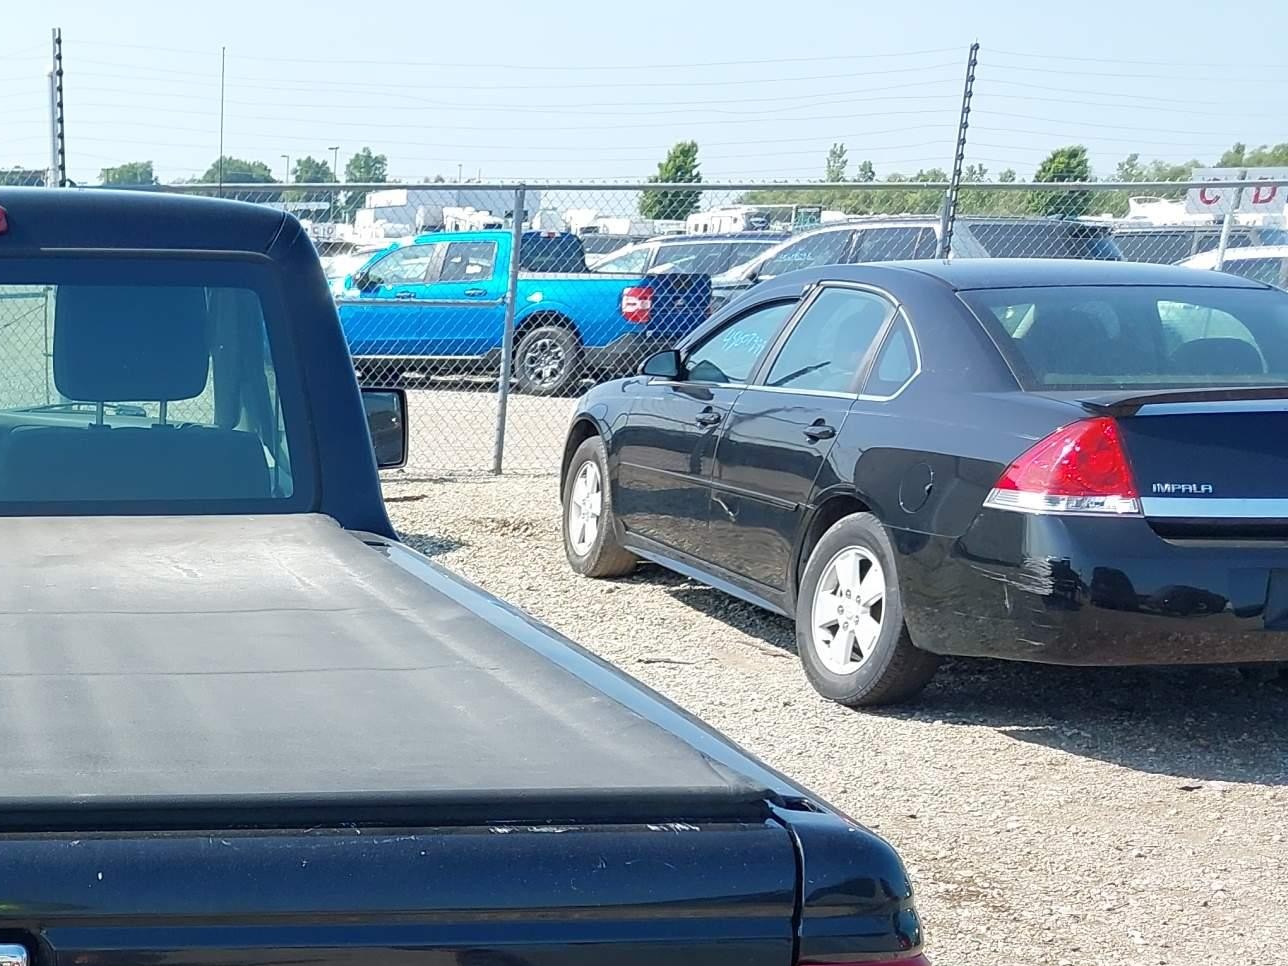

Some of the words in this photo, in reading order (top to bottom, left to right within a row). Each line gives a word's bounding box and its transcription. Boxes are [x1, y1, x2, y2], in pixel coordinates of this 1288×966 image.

[1199, 178, 1221, 205] C
[1253, 177, 1277, 204] D
[1152, 483, 1213, 493] IMPALA
